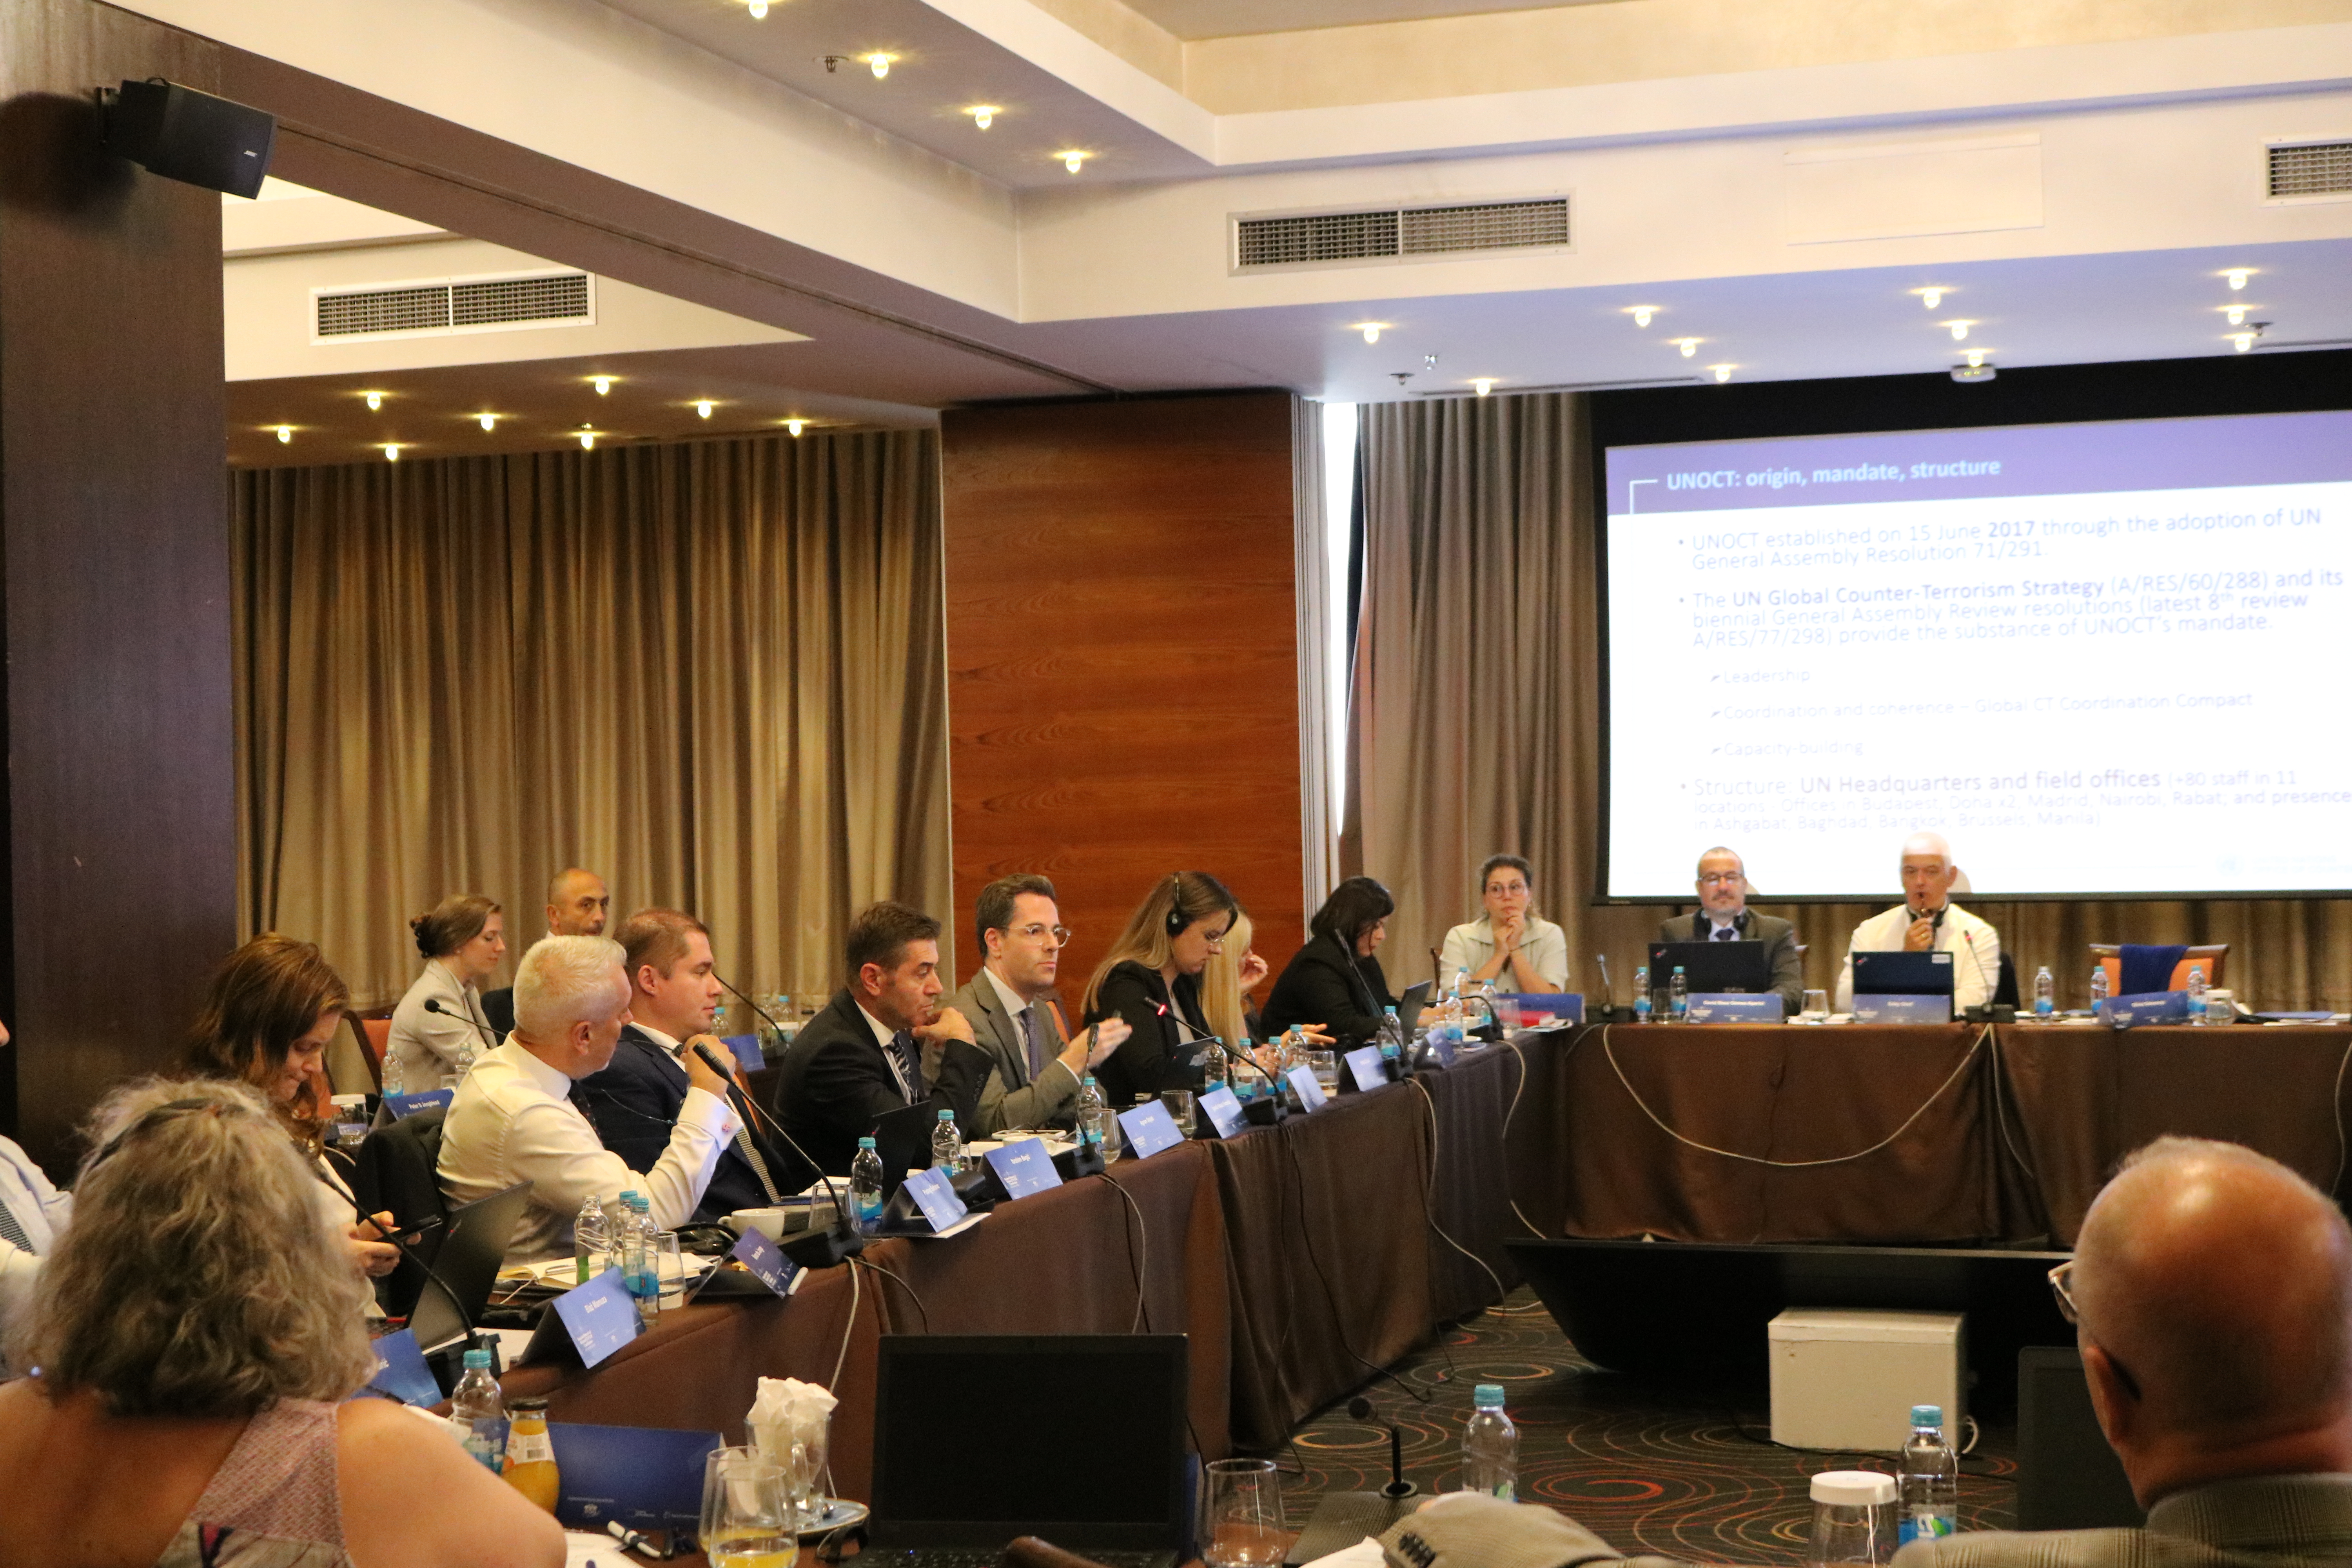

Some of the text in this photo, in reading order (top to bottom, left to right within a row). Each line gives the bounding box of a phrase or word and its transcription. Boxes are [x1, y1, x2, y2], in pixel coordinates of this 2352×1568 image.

[1667, 460, 2000, 490] UNOCT: origin, mandate, structure
[1693, 508, 2321, 551] UNOCT established on 15 June 2017 through the adoption of UN
[1692, 541, 2048, 570] General Assembly Resolution 71/291.
[1693, 569, 2343, 608] The UN Global Counter-Terrorism Strategy (A/RES/60/288) and its
[1693, 612, 1765, 628] biennial
[1773, 609, 1844, 625] General
[1852, 606, 1942, 622] Assembly
[1949, 603, 2016, 619] Review
[2024, 600, 2133, 617] resolutions
[2140, 595, 2201, 615] (latest
[2241, 595, 2308, 609] review
[1693, 628, 1831, 650] A/RES/77/298)
[1839, 626, 1909, 645] provide
[1917, 626, 1947, 641] the
[1955, 623, 2051, 640] substance
[2058, 617, 2077, 636] of
[2178, 614, 2273, 632] mandate.
[1724, 668, 1811, 684] Leadership
[1723, 704, 1828, 720] Coordination
[1833, 702, 1864, 717] and
[1869, 702, 1955, 716] coherence
[1975, 698, 2028, 713] Global
[2033, 696, 2055, 712] CT
[2059, 695, 2171, 711] Coordination
[2175, 692, 2254, 710] Compact
[1724, 739, 1864, 758] Capacity-building
[1694, 768, 2297, 797] Structure: UN Headquarters and field offices (+80 staff in 11
